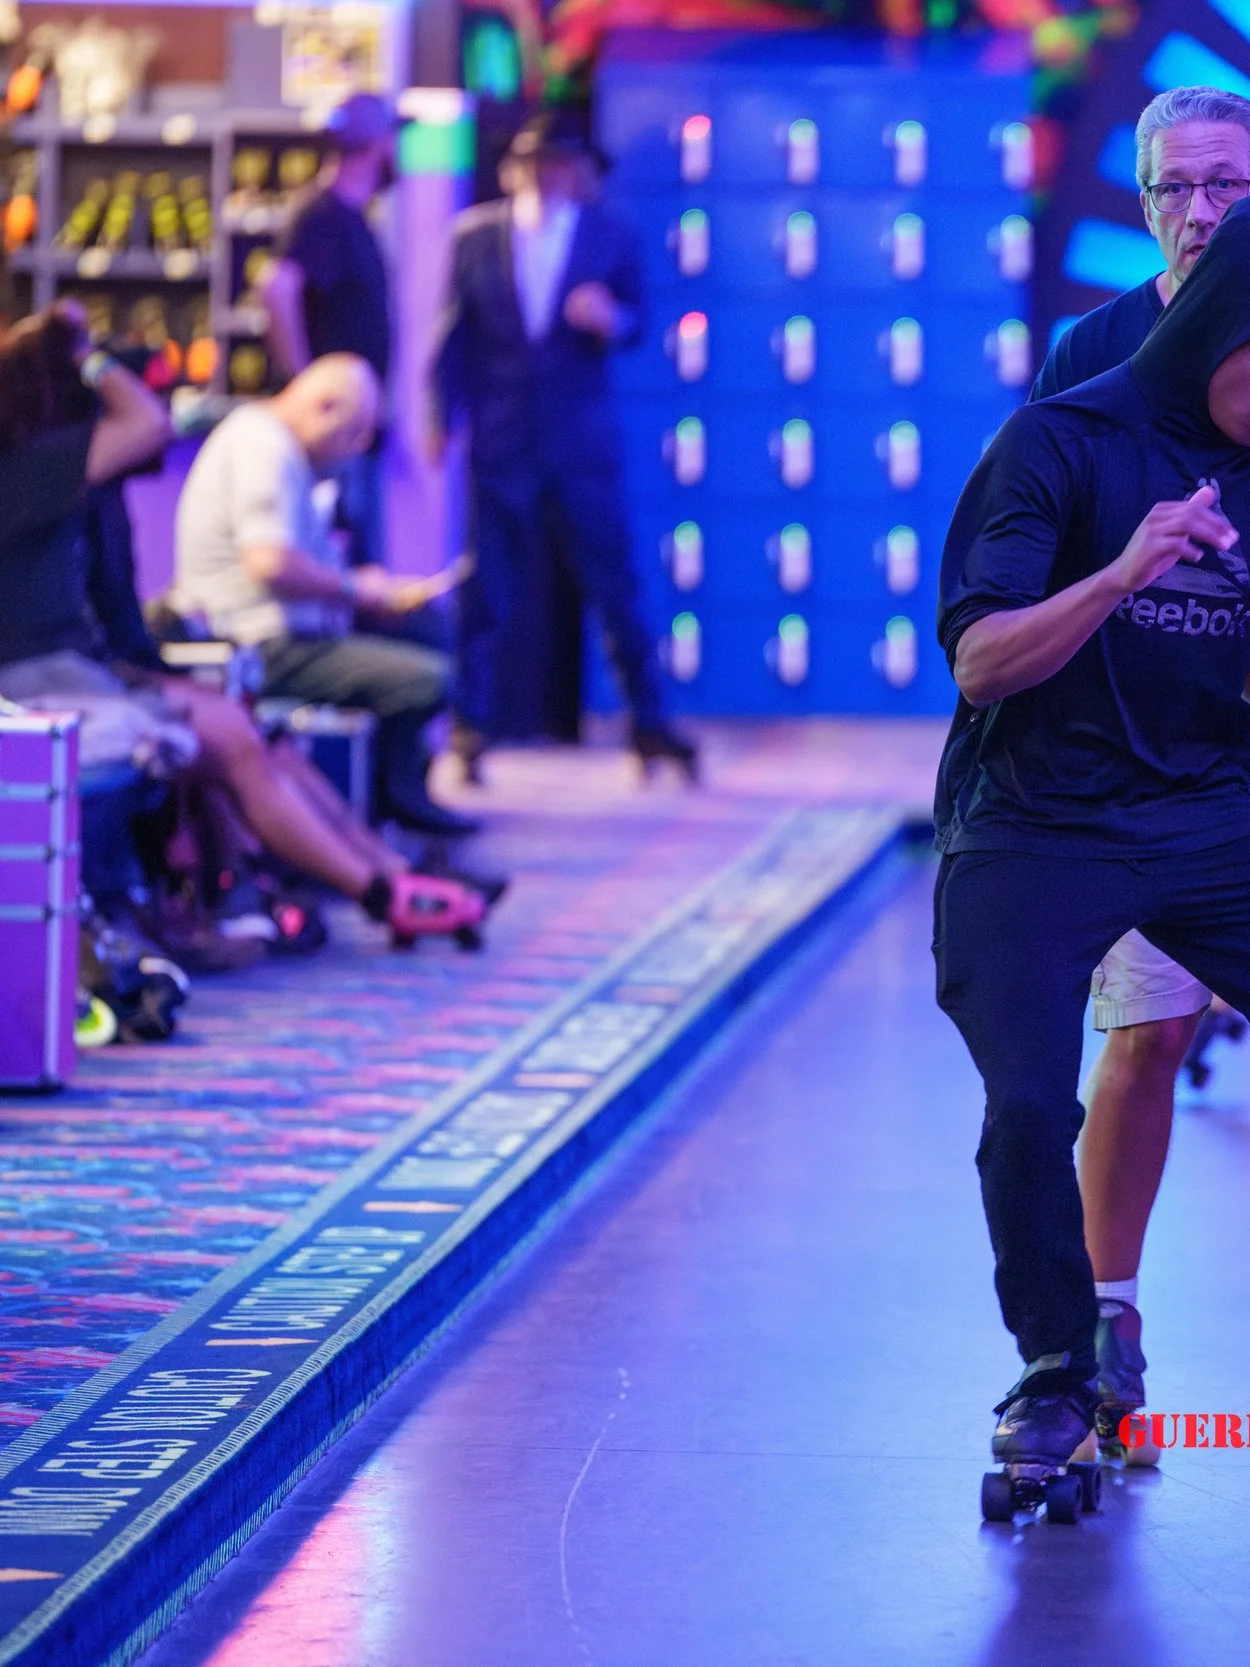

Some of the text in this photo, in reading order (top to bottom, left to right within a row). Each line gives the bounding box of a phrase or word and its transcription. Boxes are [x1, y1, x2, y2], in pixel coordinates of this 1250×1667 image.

[0, 1368, 272, 1537] CAUTION STEP DOWN
